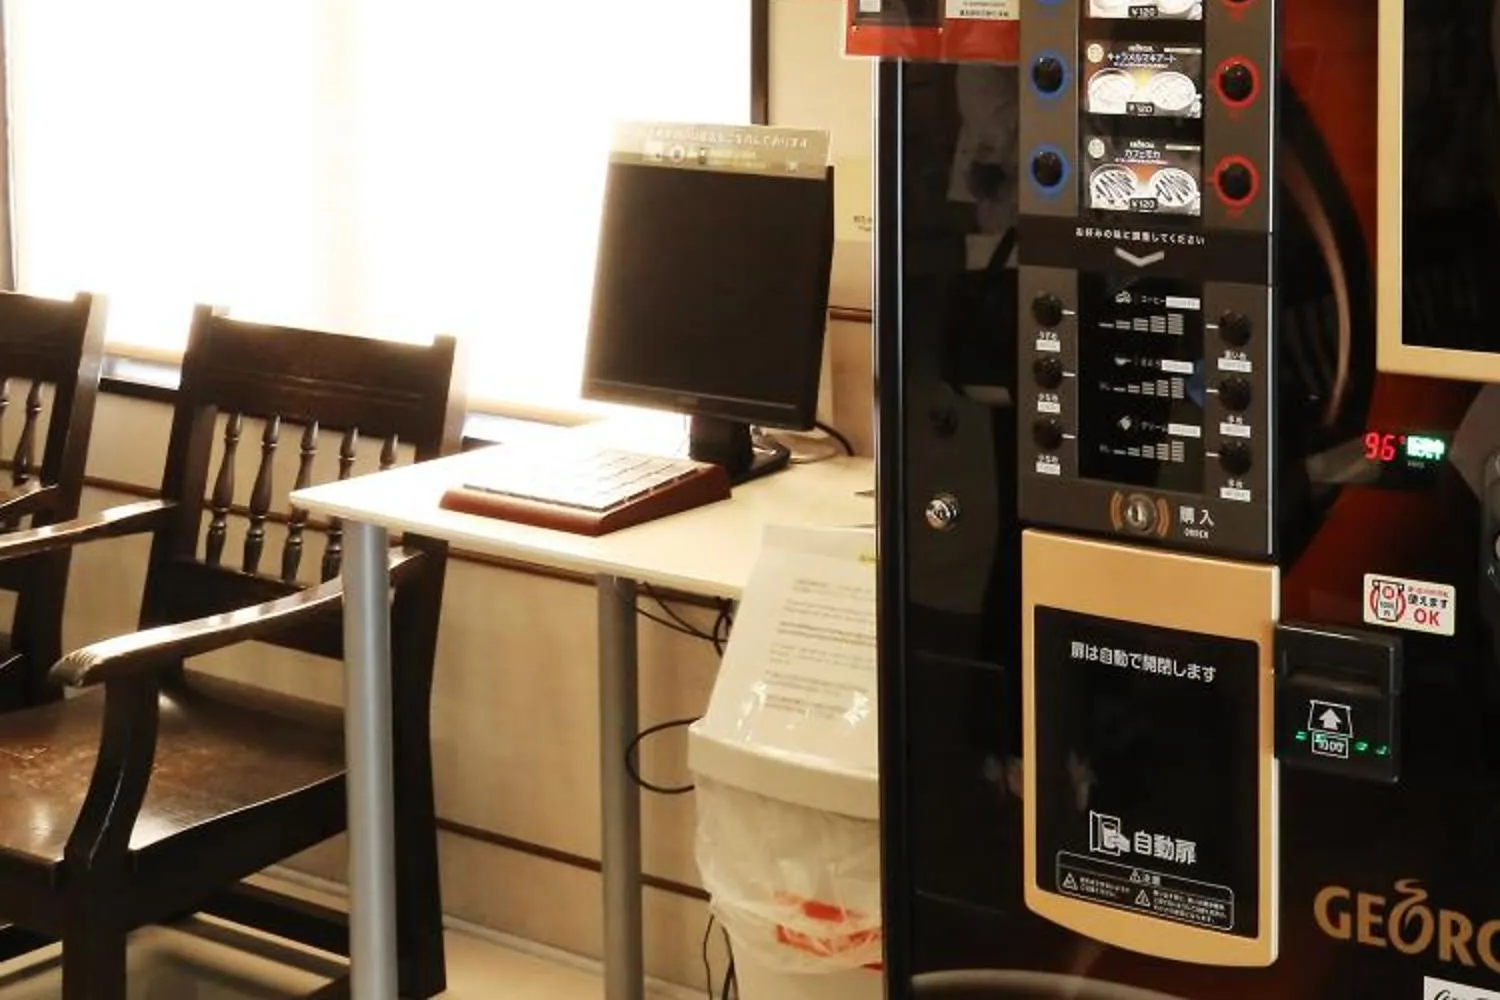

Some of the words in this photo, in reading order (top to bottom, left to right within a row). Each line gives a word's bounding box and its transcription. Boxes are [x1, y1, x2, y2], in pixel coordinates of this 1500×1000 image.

[1180, 505, 1215, 526] 購入
[1414, 608, 1440, 627] OK
[1071, 641, 1217, 683] 扉は自動で開閉します
[1133, 830, 1198, 865] 自動扉
